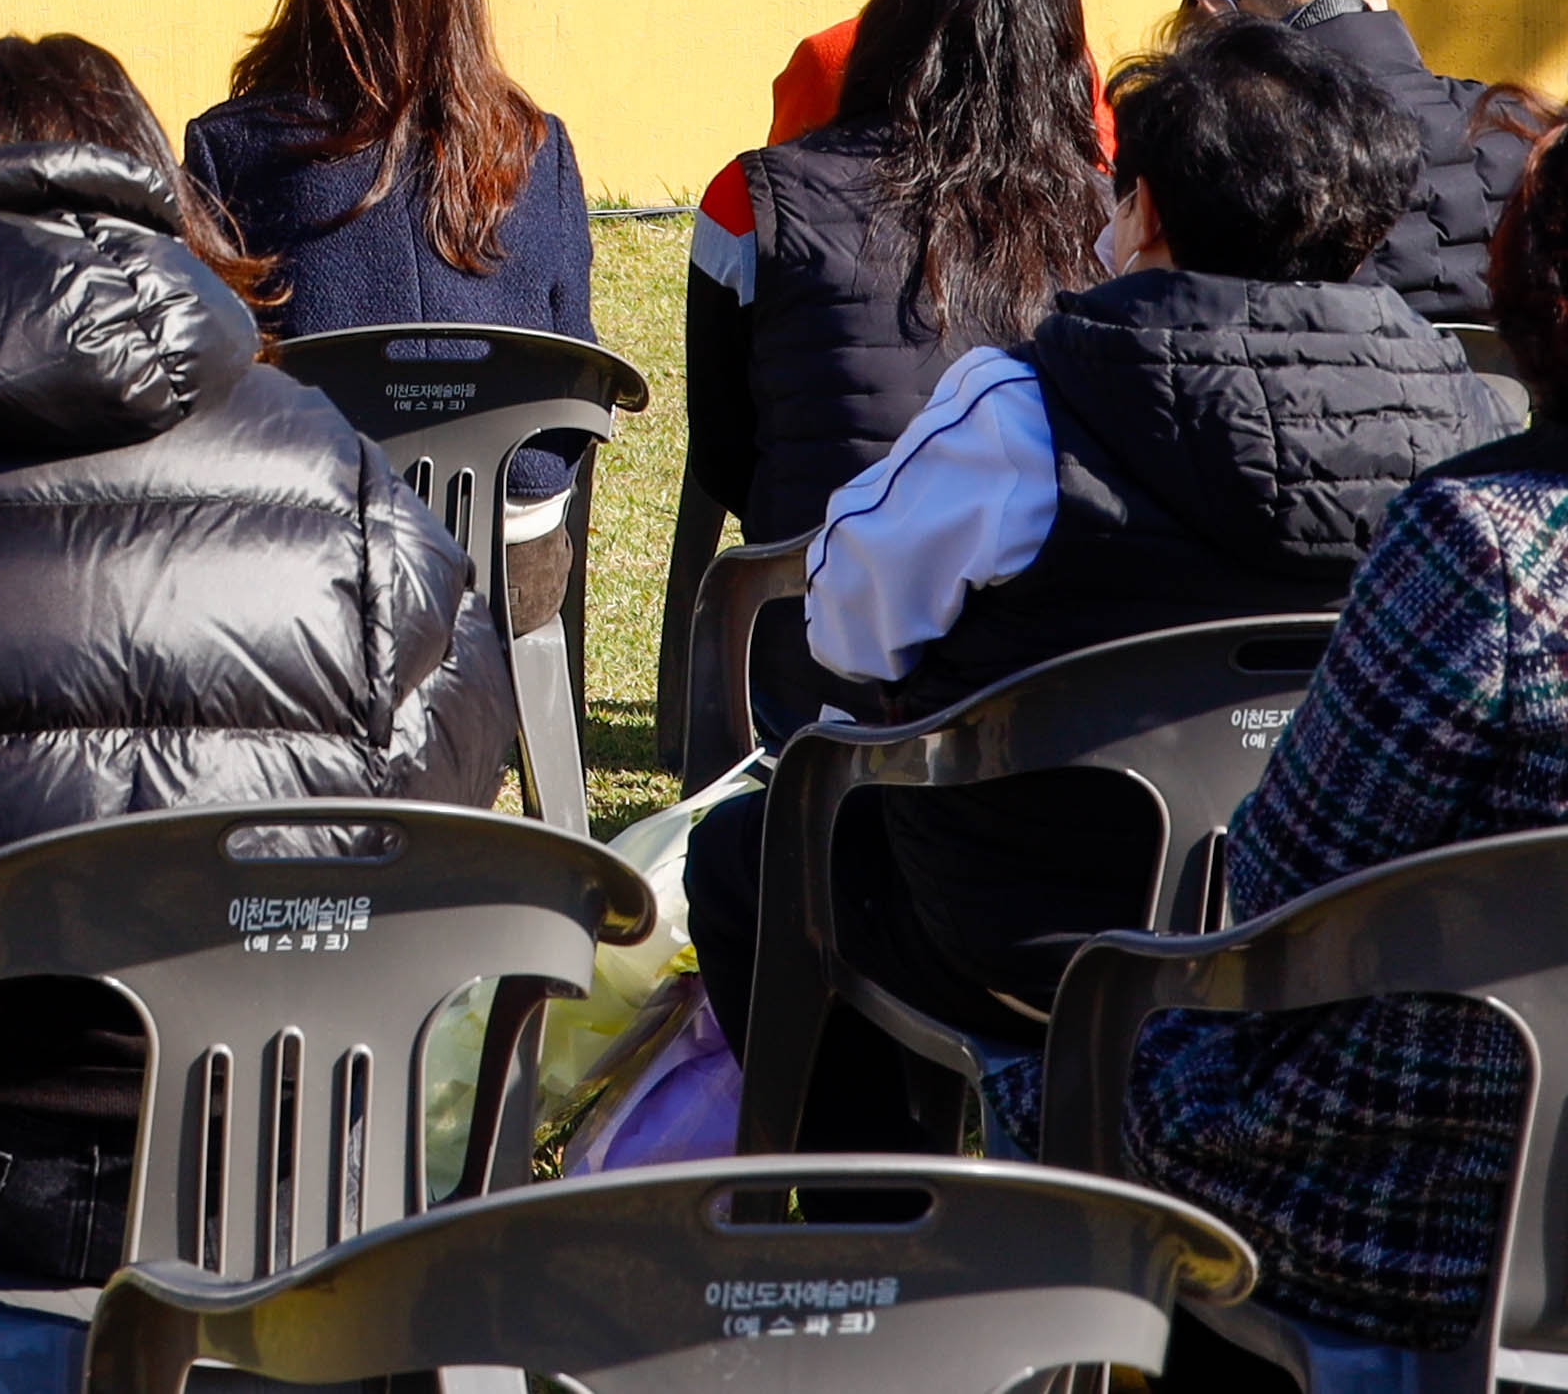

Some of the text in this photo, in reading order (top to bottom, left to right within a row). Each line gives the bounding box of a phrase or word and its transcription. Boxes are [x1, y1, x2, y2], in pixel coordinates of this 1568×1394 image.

[1231, 708, 1295, 730] 이천도자
[228, 896, 372, 932] 이천도자예술마을
[705, 1276, 899, 1310] 이천도자예술마을
